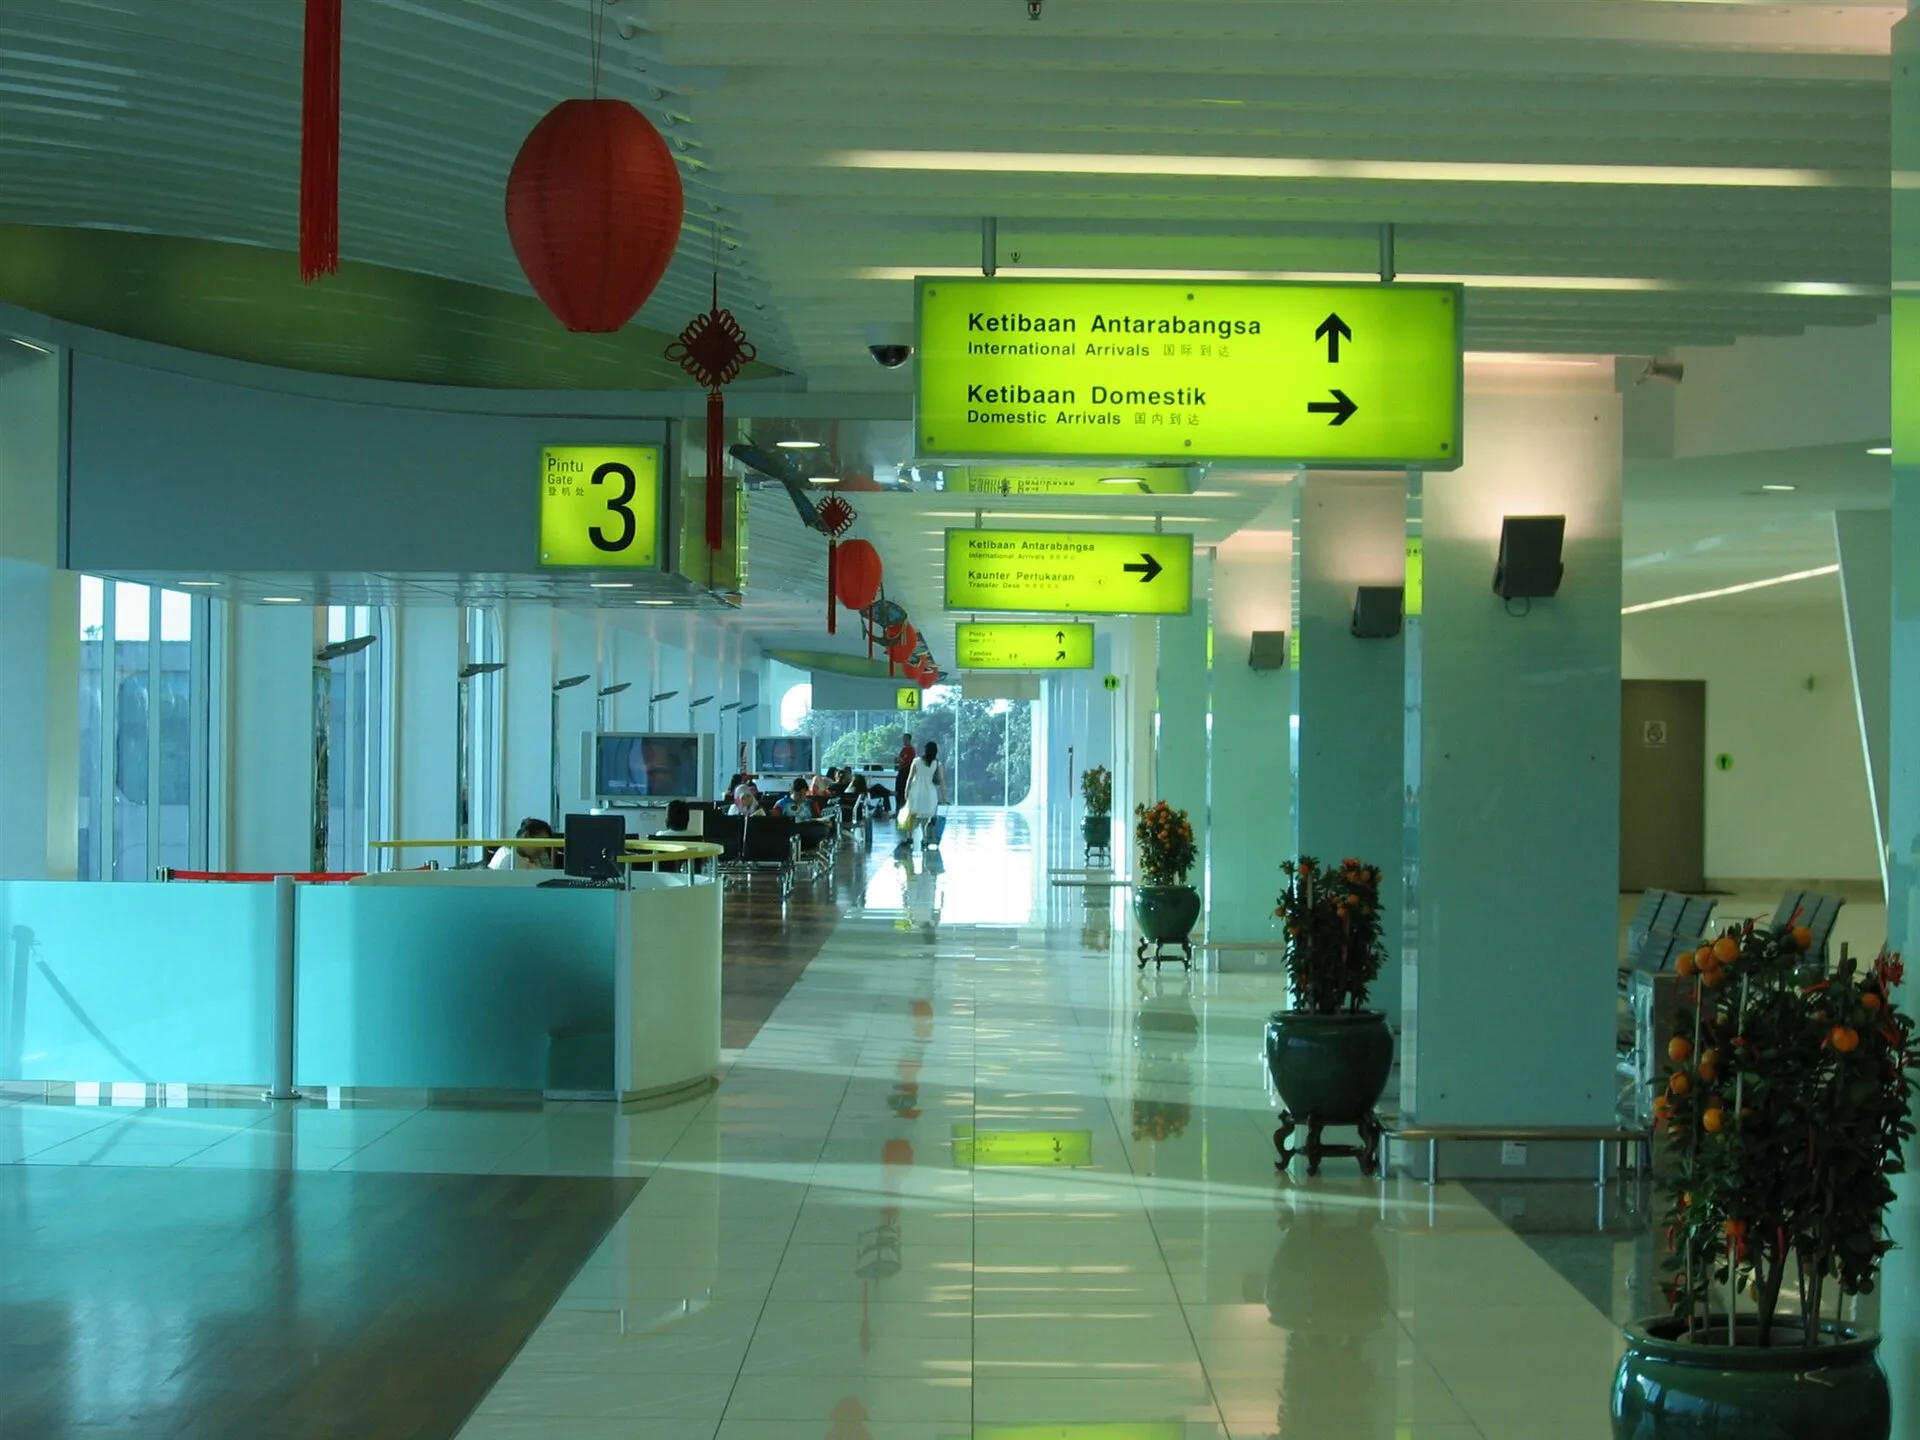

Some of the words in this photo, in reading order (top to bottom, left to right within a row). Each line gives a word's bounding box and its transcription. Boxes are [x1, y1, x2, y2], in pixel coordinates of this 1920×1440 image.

[968, 313, 1076, 332] Ketibaan
[1090, 314, 1261, 339] Antarabangsa
[968, 342, 1075, 356] International
[1085, 343, 1150, 356] Arrivals
[1163, 344, 1230, 357] 国际到达
[968, 384, 1075, 404] Ketibaan
[1092, 386, 1207, 405] Domestik
[967, 410, 1047, 424] Domestic
[1056, 411, 1121, 425] Arrivals
[1134, 412, 1200, 426] 国内到达
[547, 458, 584, 472] Pintu
[547, 474, 573, 485] Gate
[588, 462, 636, 552] 3
[968, 540, 1016, 549] Ketibaan
[1021, 541, 1095, 553] Antarabangsa
[968, 570, 1010, 580] Kaunter
[1016, 571, 1075, 581] Pertukaran
[906, 691, 915, 707] 4
